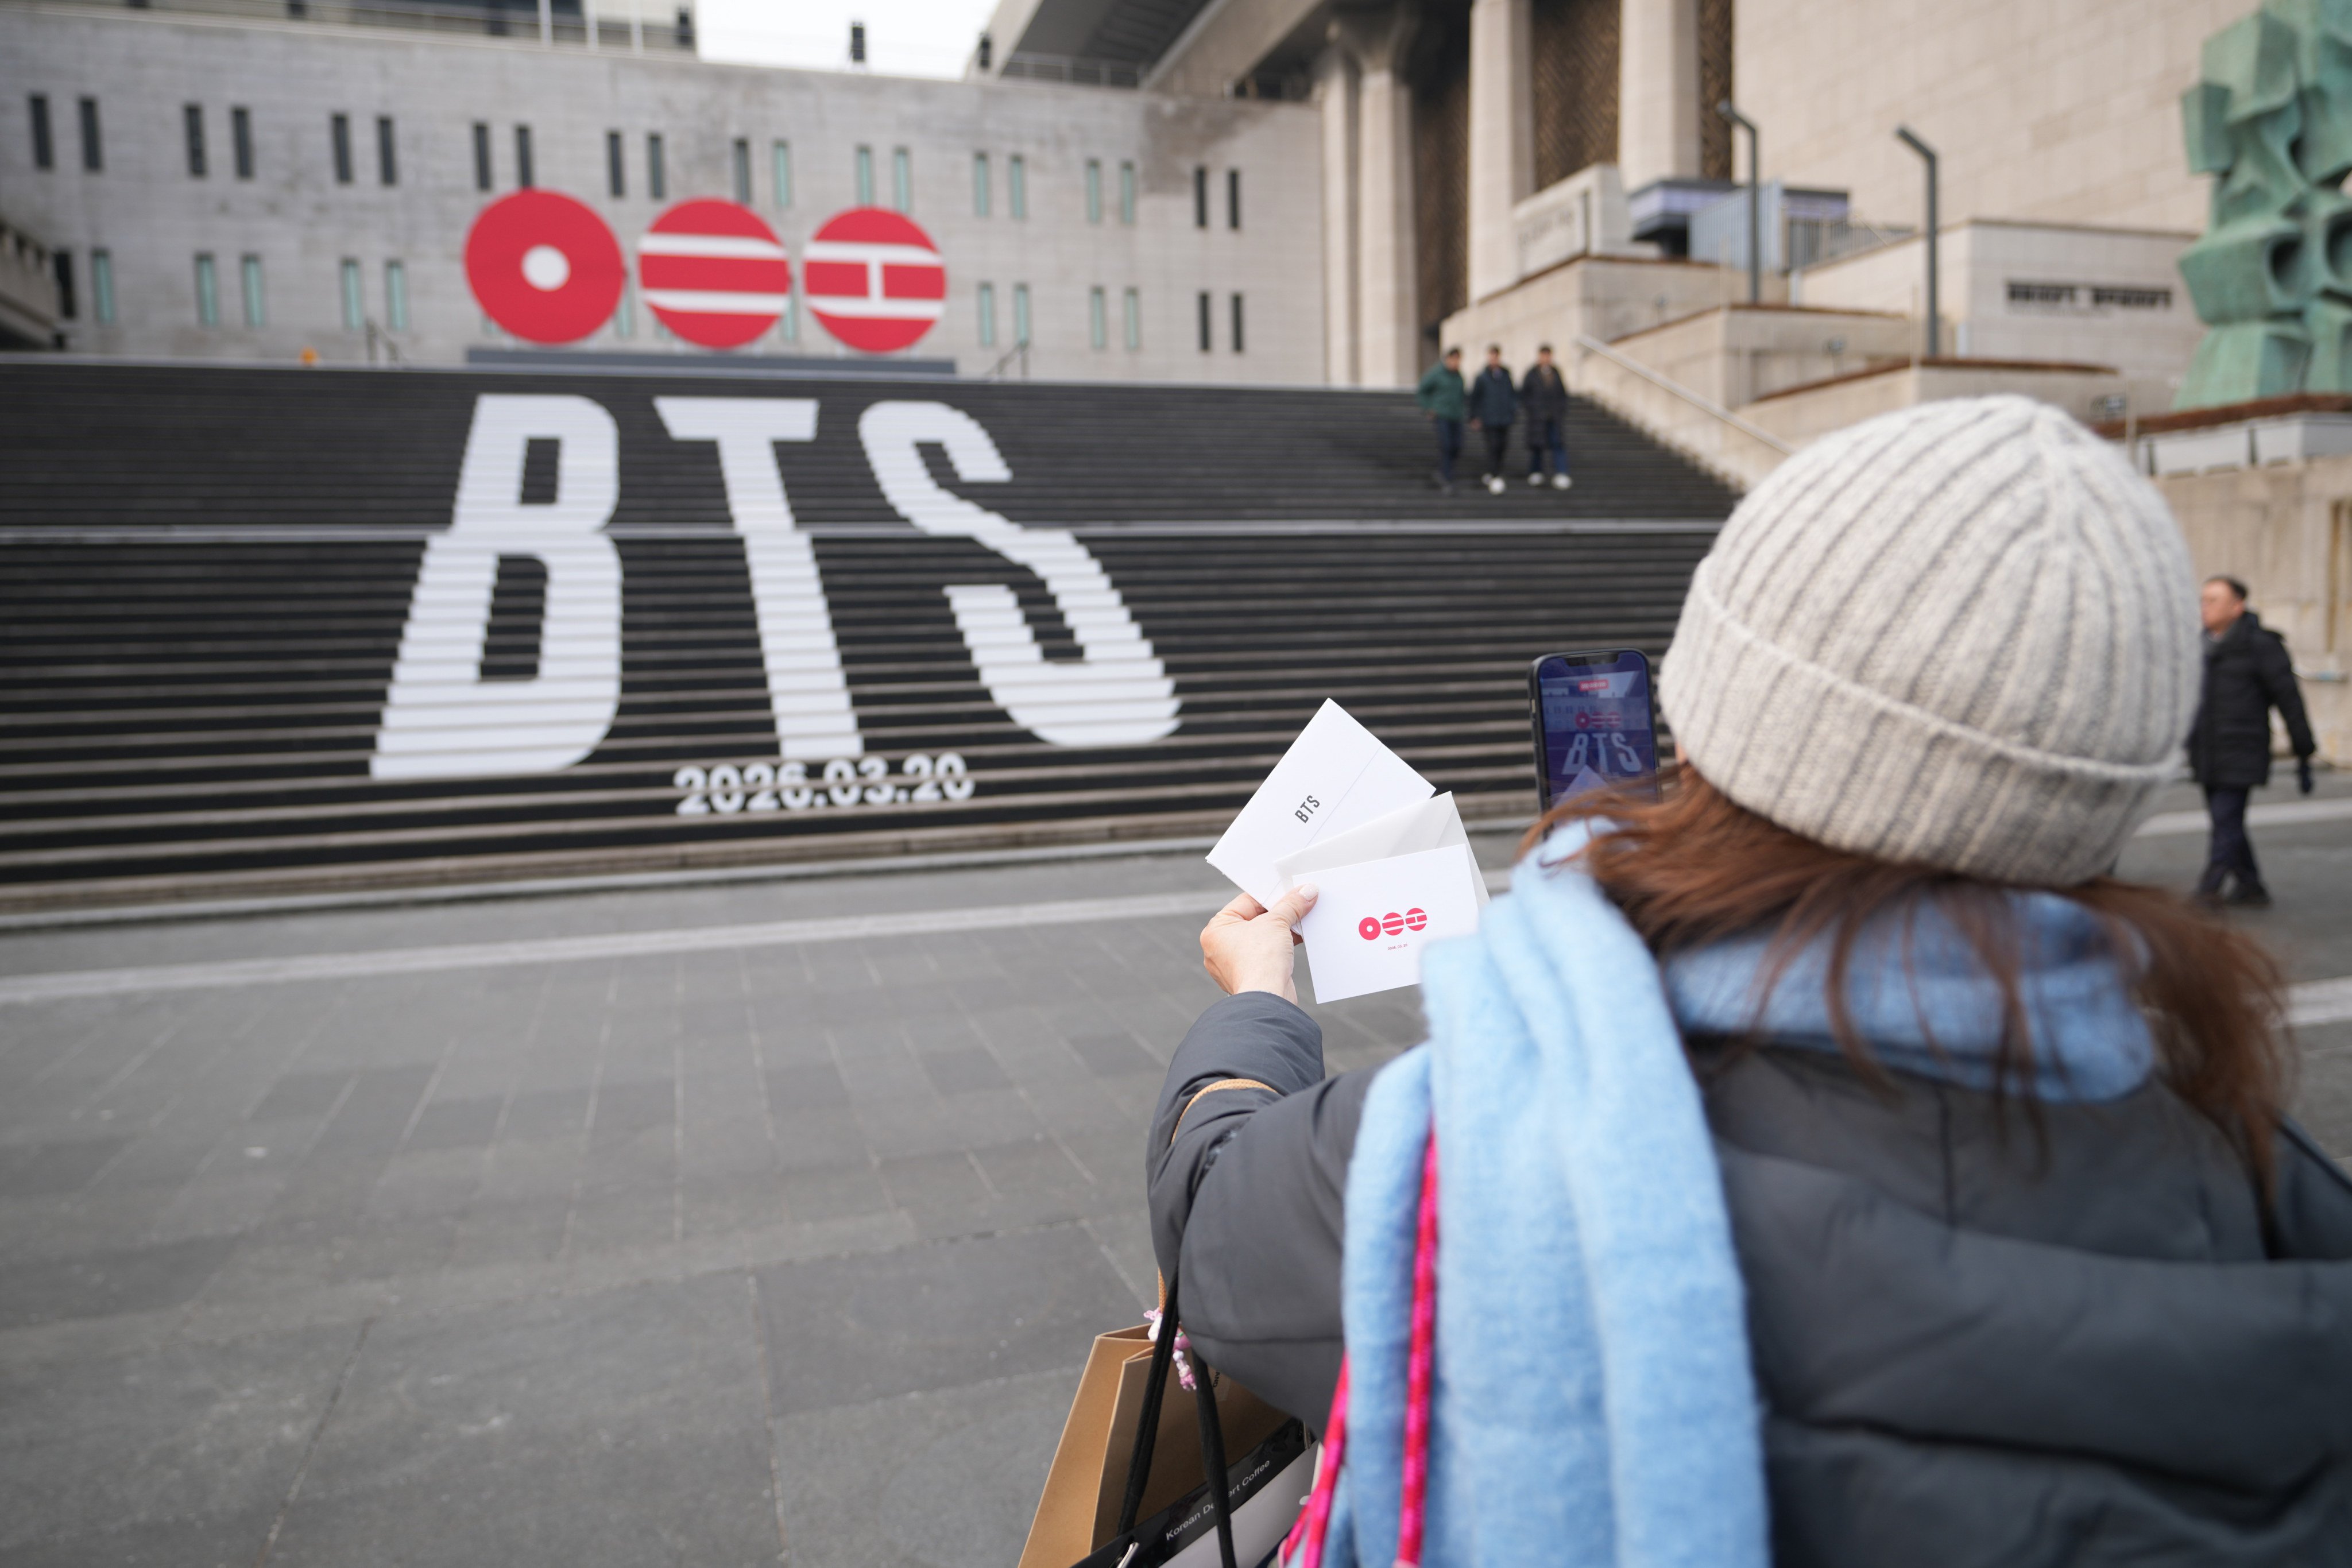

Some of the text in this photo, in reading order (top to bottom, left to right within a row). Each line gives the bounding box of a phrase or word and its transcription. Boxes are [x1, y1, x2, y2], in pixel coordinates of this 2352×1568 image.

[369, 393, 1182, 780] BTS
[673, 751, 977, 815] 2026.03.20
[1561, 733, 1642, 775] BTS
[1294, 795, 1320, 823] BTS
[1166, 1512, 1201, 1540] Korean
[1242, 1460, 1270, 1486] Coffee
